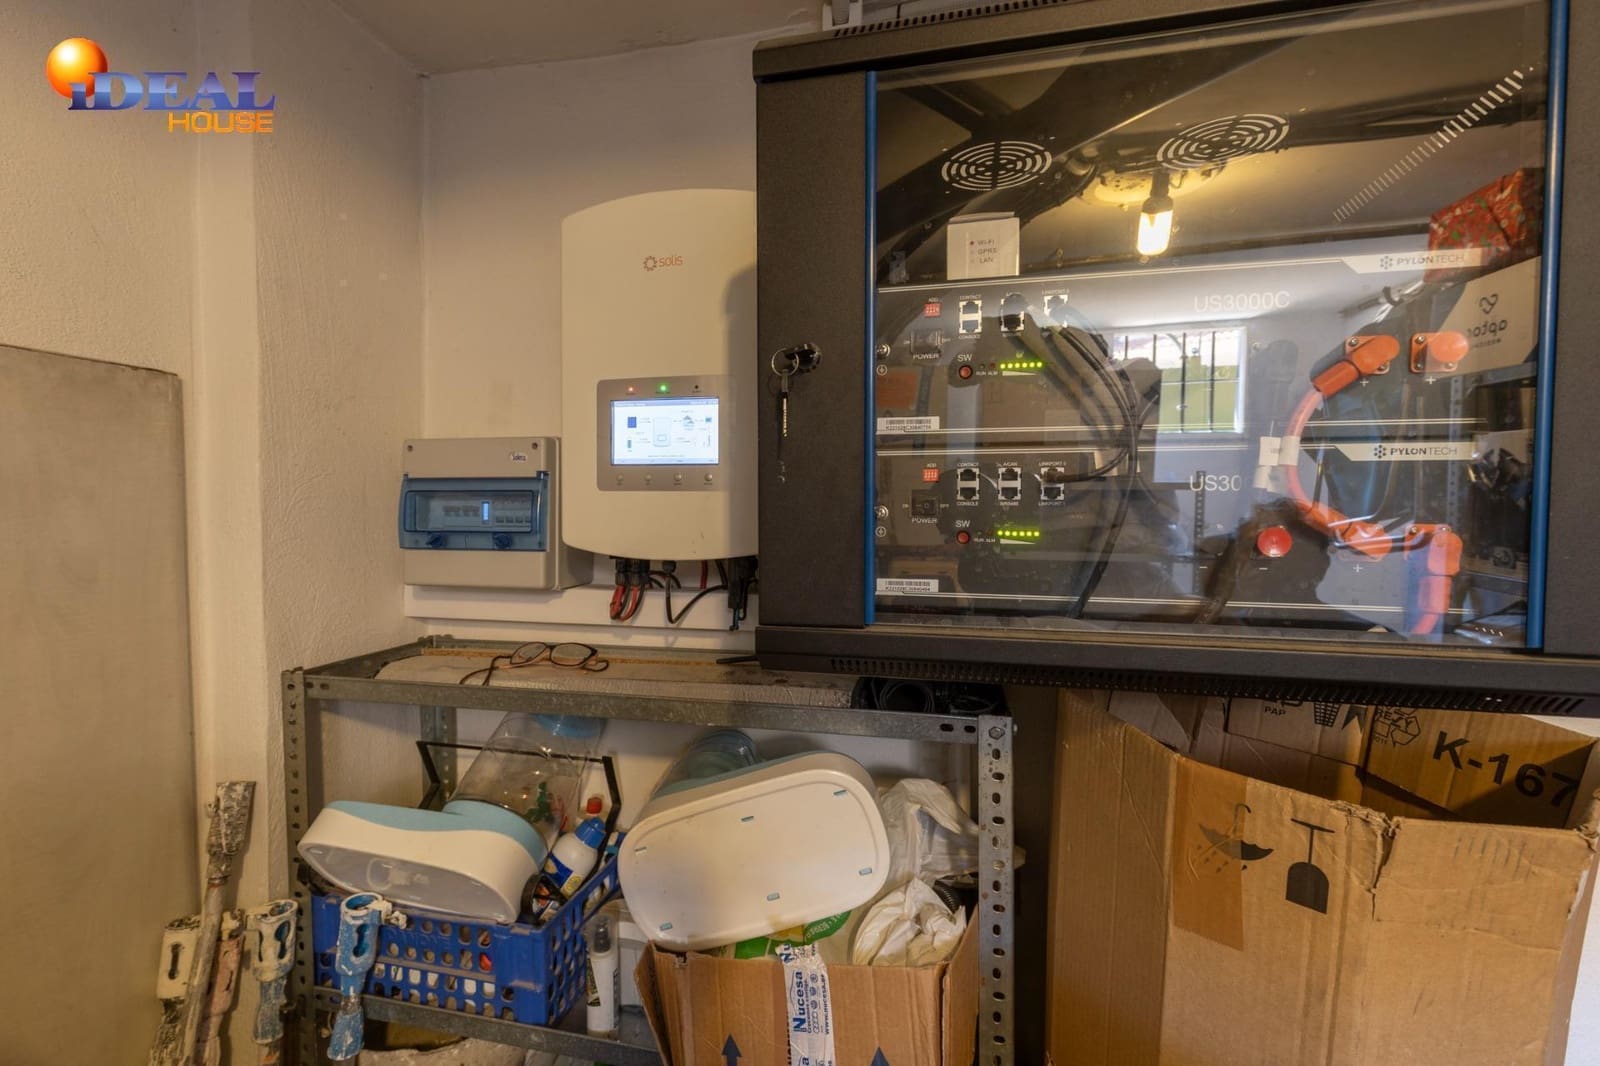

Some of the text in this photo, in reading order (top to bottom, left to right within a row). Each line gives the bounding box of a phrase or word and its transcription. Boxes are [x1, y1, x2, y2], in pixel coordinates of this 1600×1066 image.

[658, 254, 684, 267] solis
[1396, 253, 1465, 265] PYLONTECH
[1193, 291, 1291, 313] US3000C
[912, 352, 940, 360] POWER
[957, 353, 973, 362] SW
[1390, 446, 1458, 456] PYLONTECH
[955, 520, 970, 528] SW
[1264, 706, 1286, 716] PAP
[1433, 730, 1579, 807] K-167
[792, 971, 807, 1033] Nucesa
